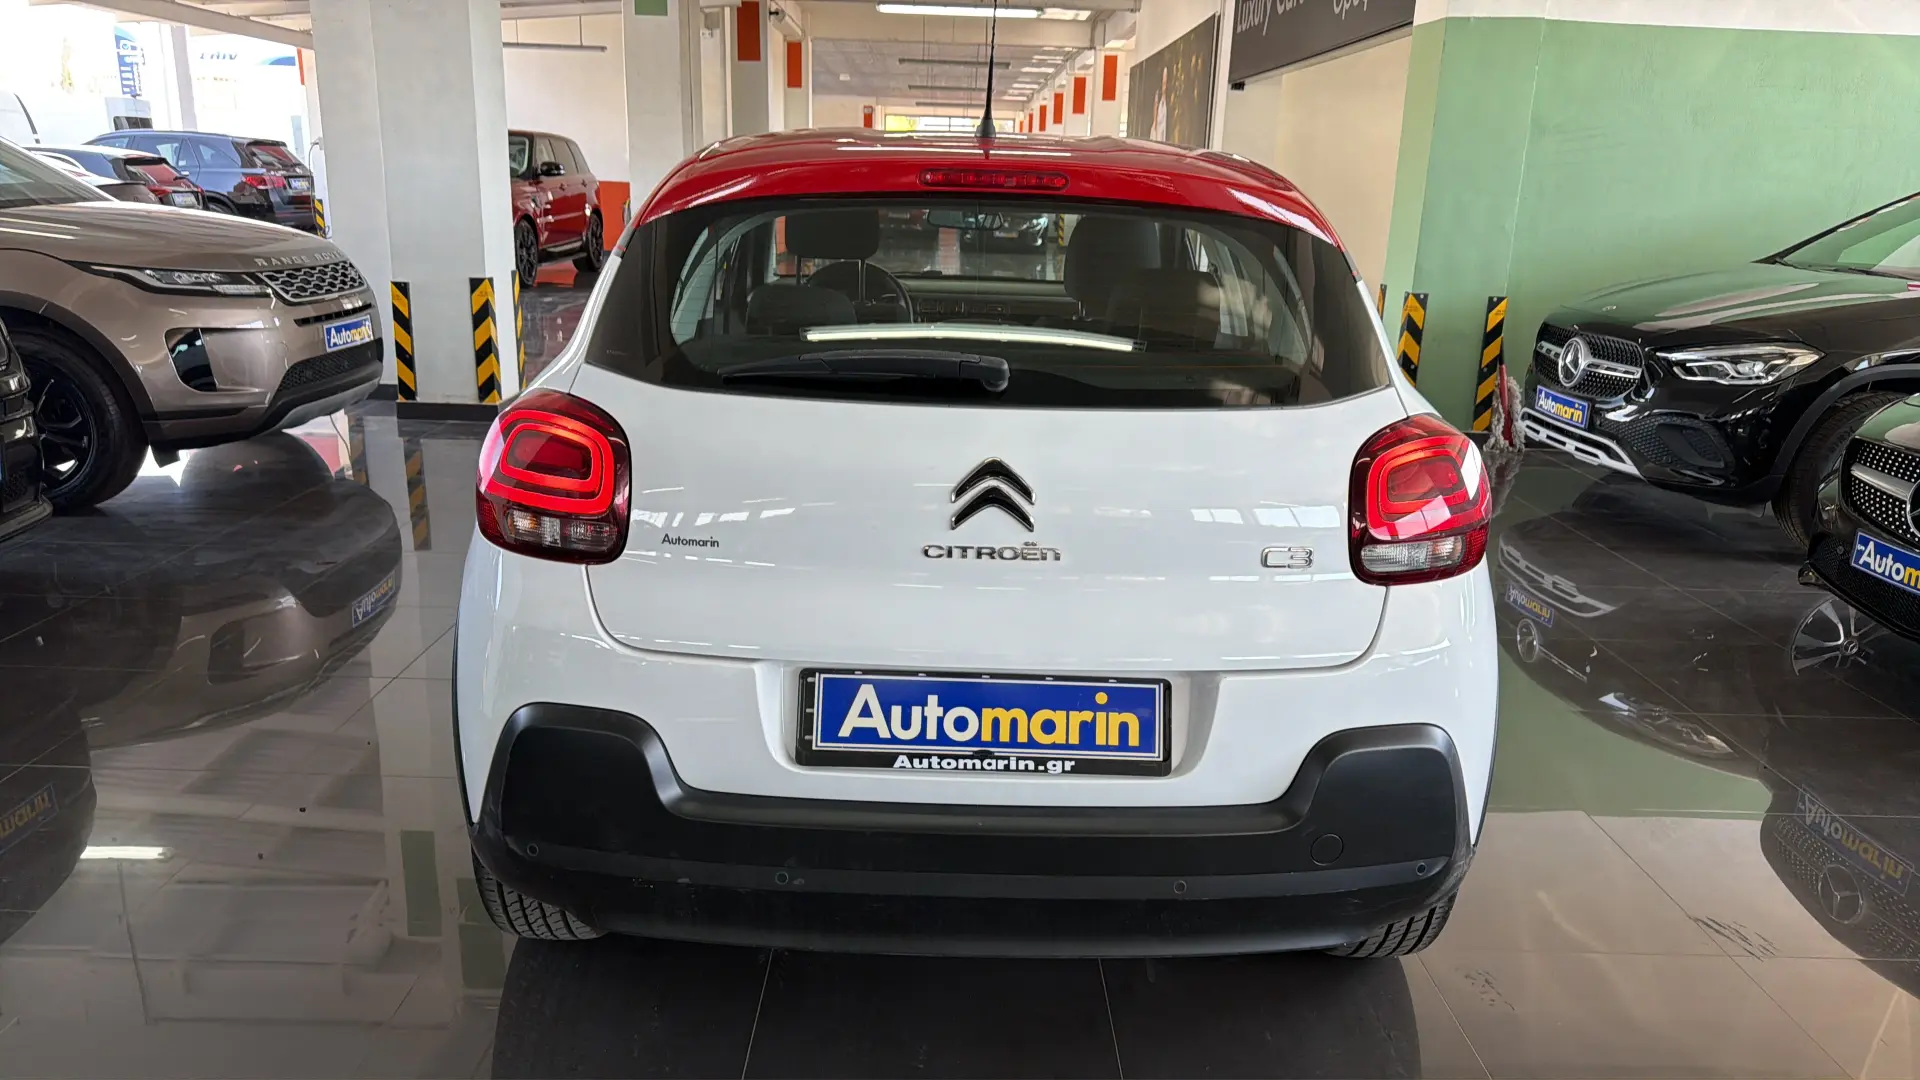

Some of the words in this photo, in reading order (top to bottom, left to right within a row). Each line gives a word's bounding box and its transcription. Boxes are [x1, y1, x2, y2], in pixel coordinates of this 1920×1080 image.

[254, 255, 310, 266] RANGE
[1538, 391, 1583, 423] Automarin
[661, 533, 720, 548] Automarin
[1260, 546, 1314, 569] C3
[838, 683, 1140, 747] Automarin
[892, 754, 1076, 774] Automarin.gr
